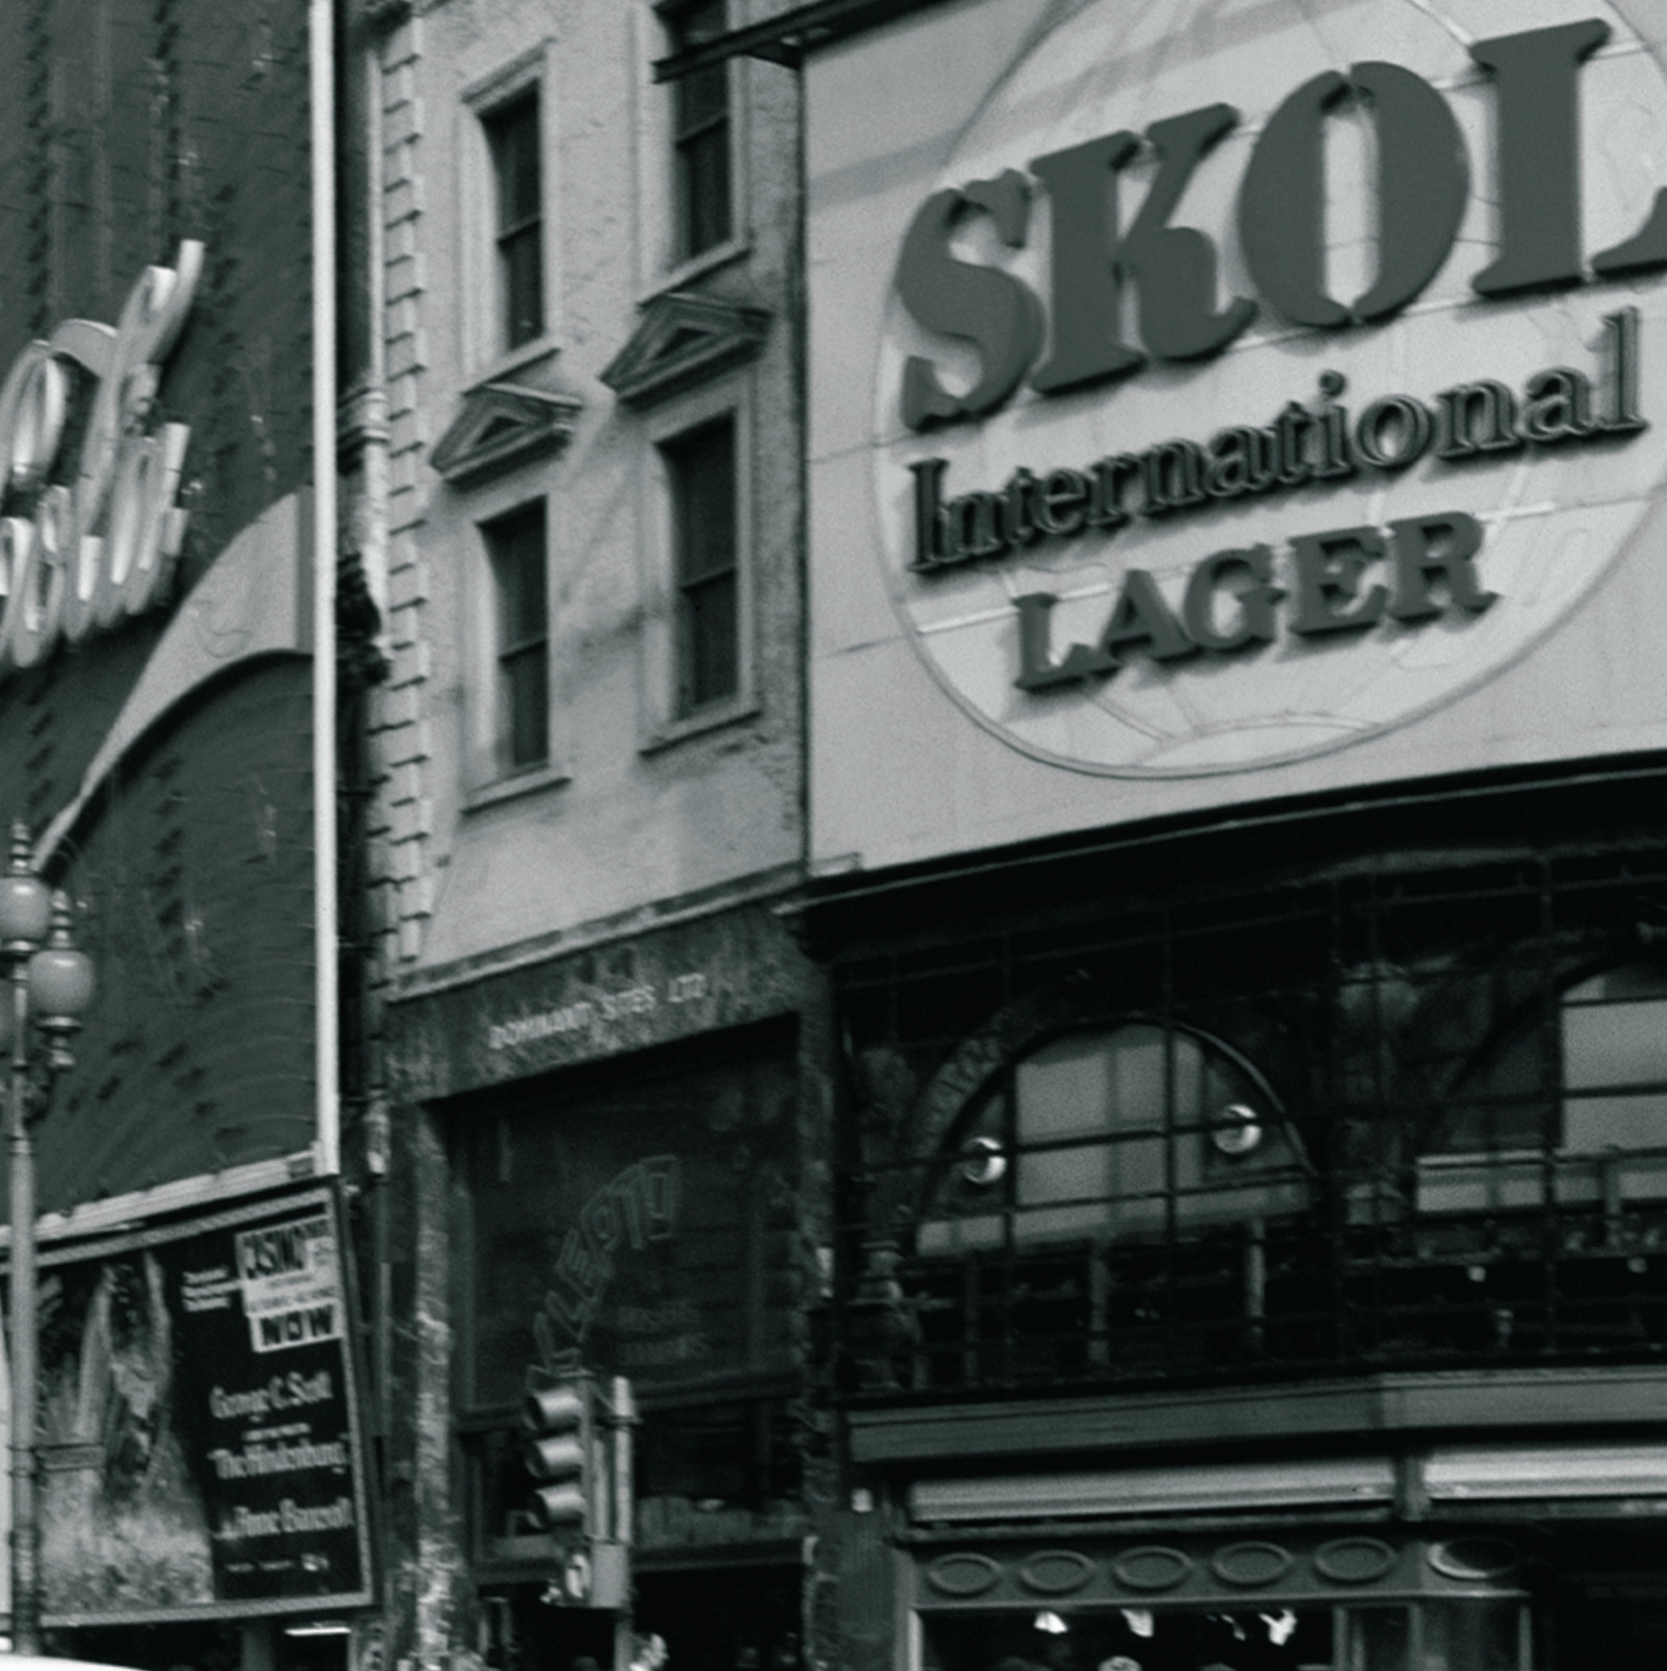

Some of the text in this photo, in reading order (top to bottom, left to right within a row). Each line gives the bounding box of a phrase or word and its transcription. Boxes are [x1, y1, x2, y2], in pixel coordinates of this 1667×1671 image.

[894, 18, 1667, 434] SKOL
[905, 305, 1650, 577] International
[1014, 510, 1504, 692] LAGER
[259, 1302, 335, 1348] NOW
